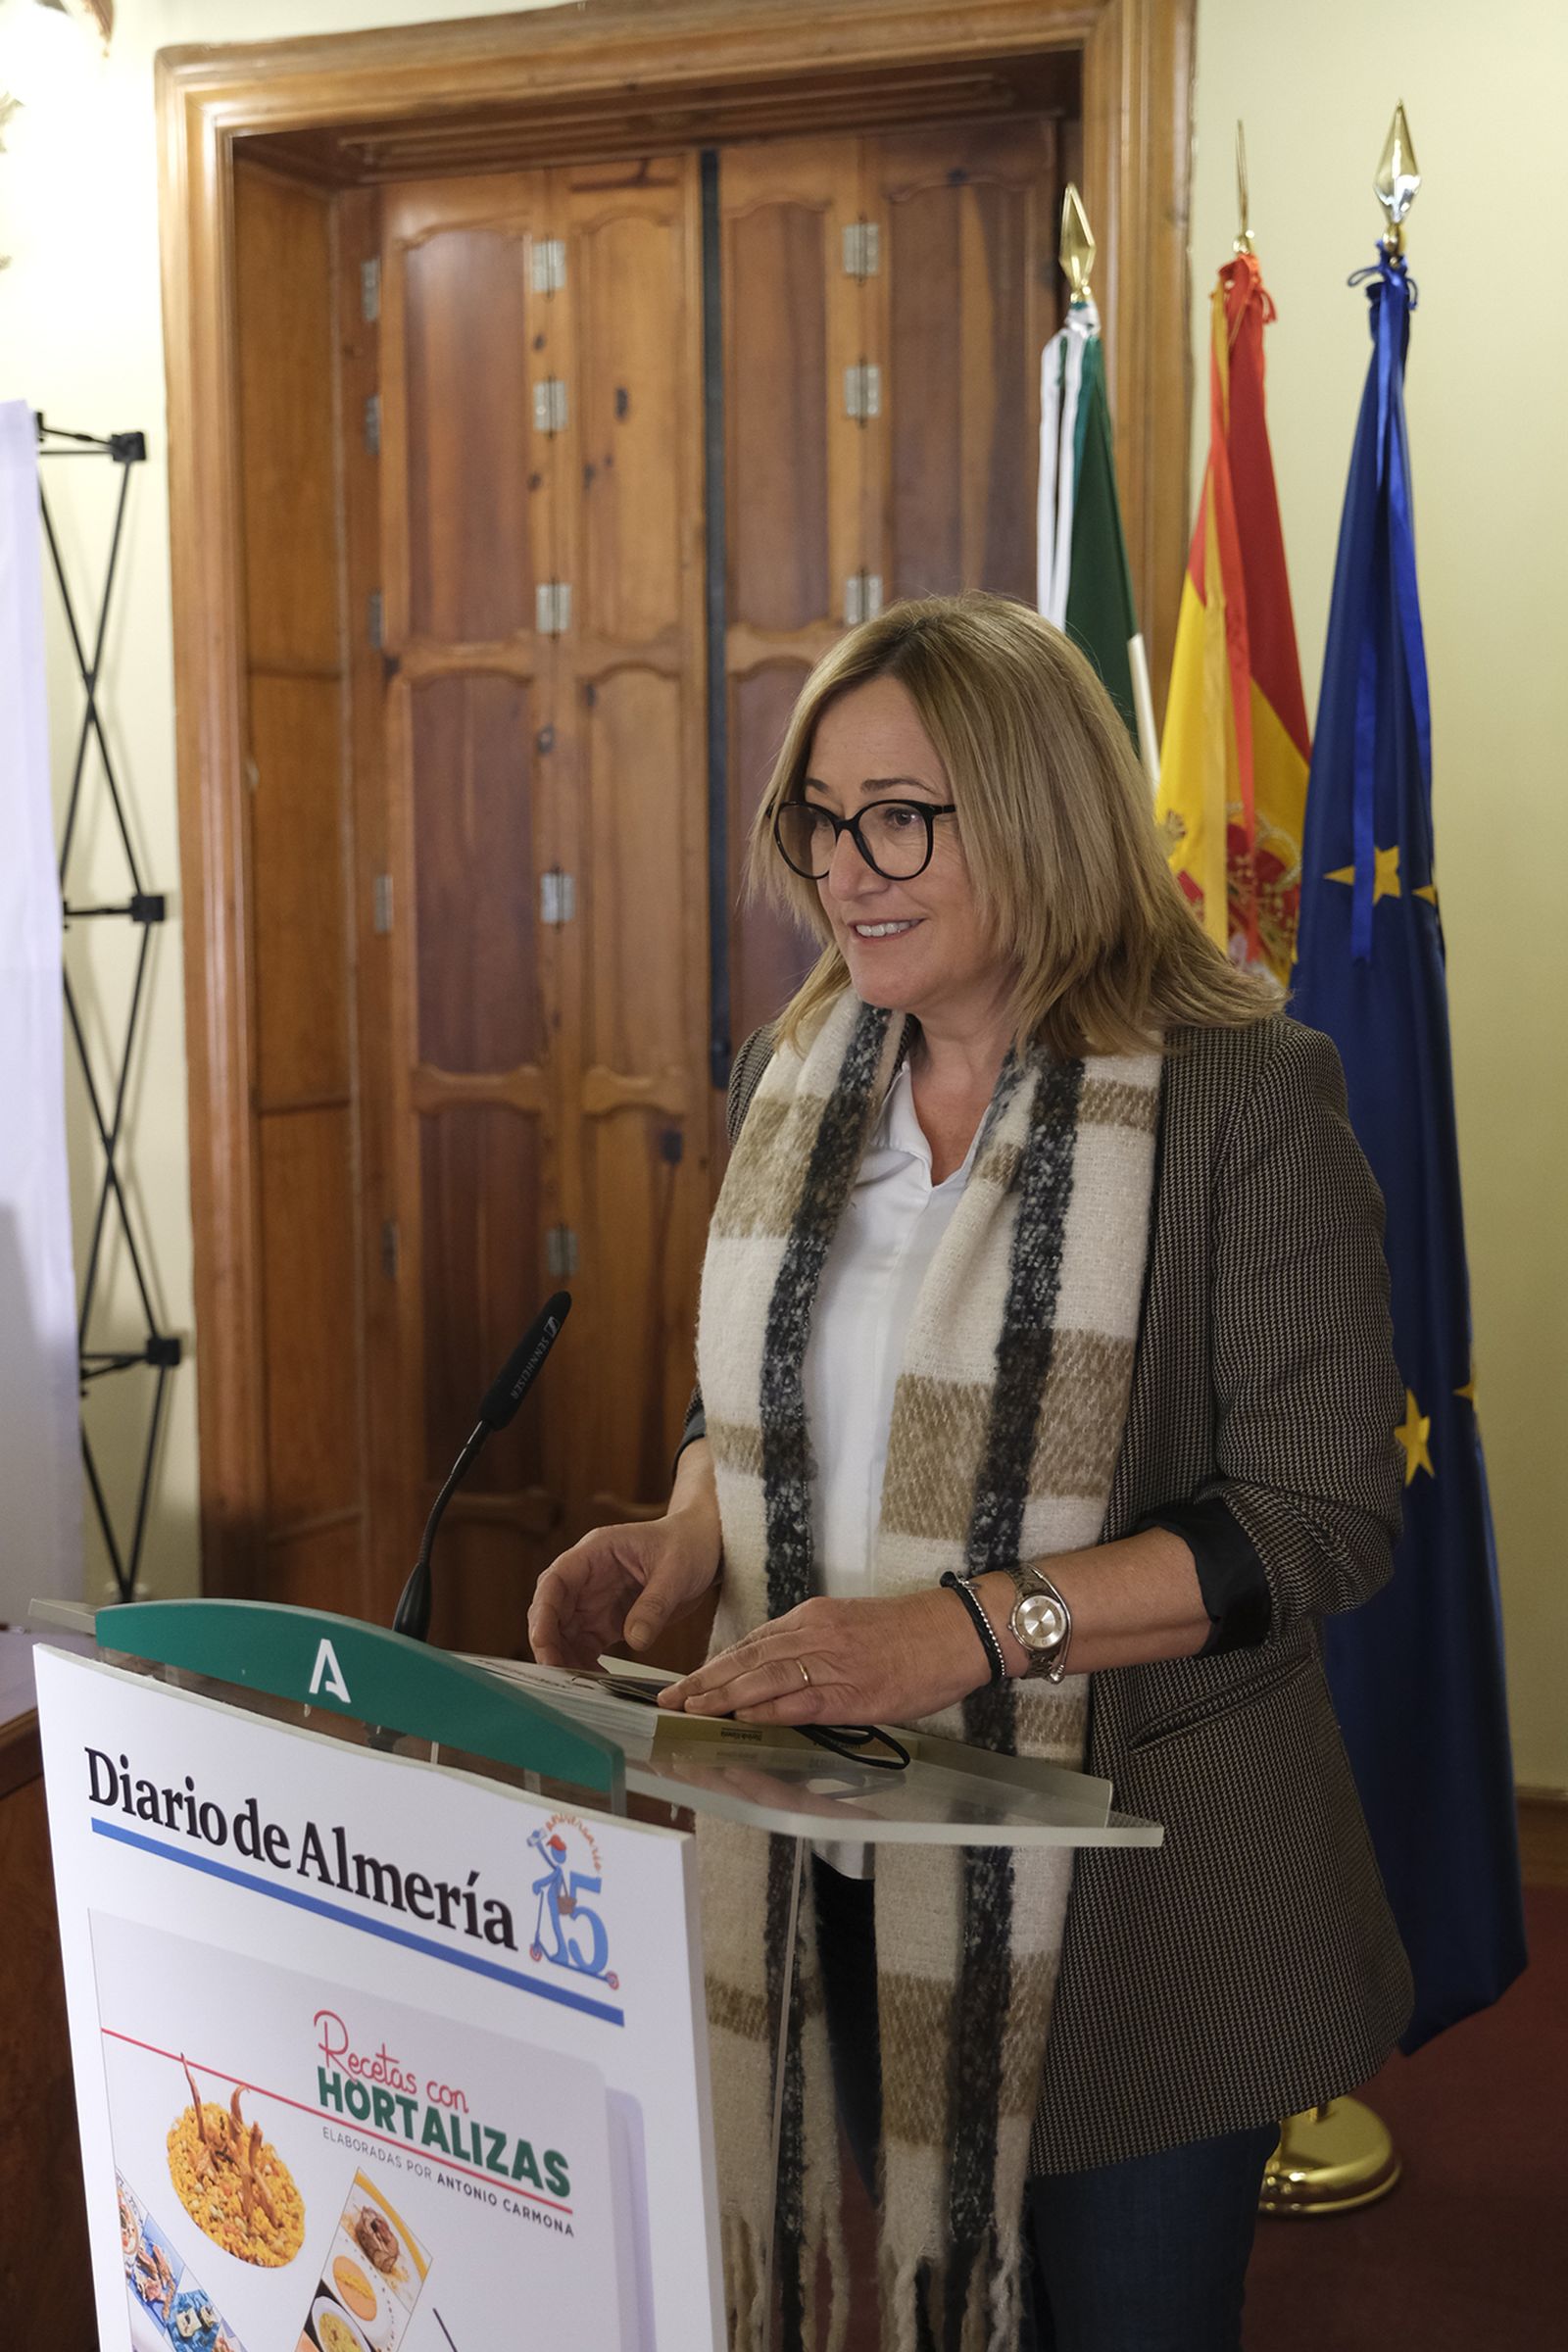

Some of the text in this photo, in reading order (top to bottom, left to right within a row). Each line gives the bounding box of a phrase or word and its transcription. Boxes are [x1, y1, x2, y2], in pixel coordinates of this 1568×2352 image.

[511, 1336, 549, 1399] SENNHEISER
[84, 1746, 518, 1951] Diario de Almería
[313, 2010, 469, 2114] Recetas con
[318, 2066, 571, 2198] HORTALIZAS
[322, 2127, 574, 2237] ELABORADAS POR ANTONIO CARMONA
